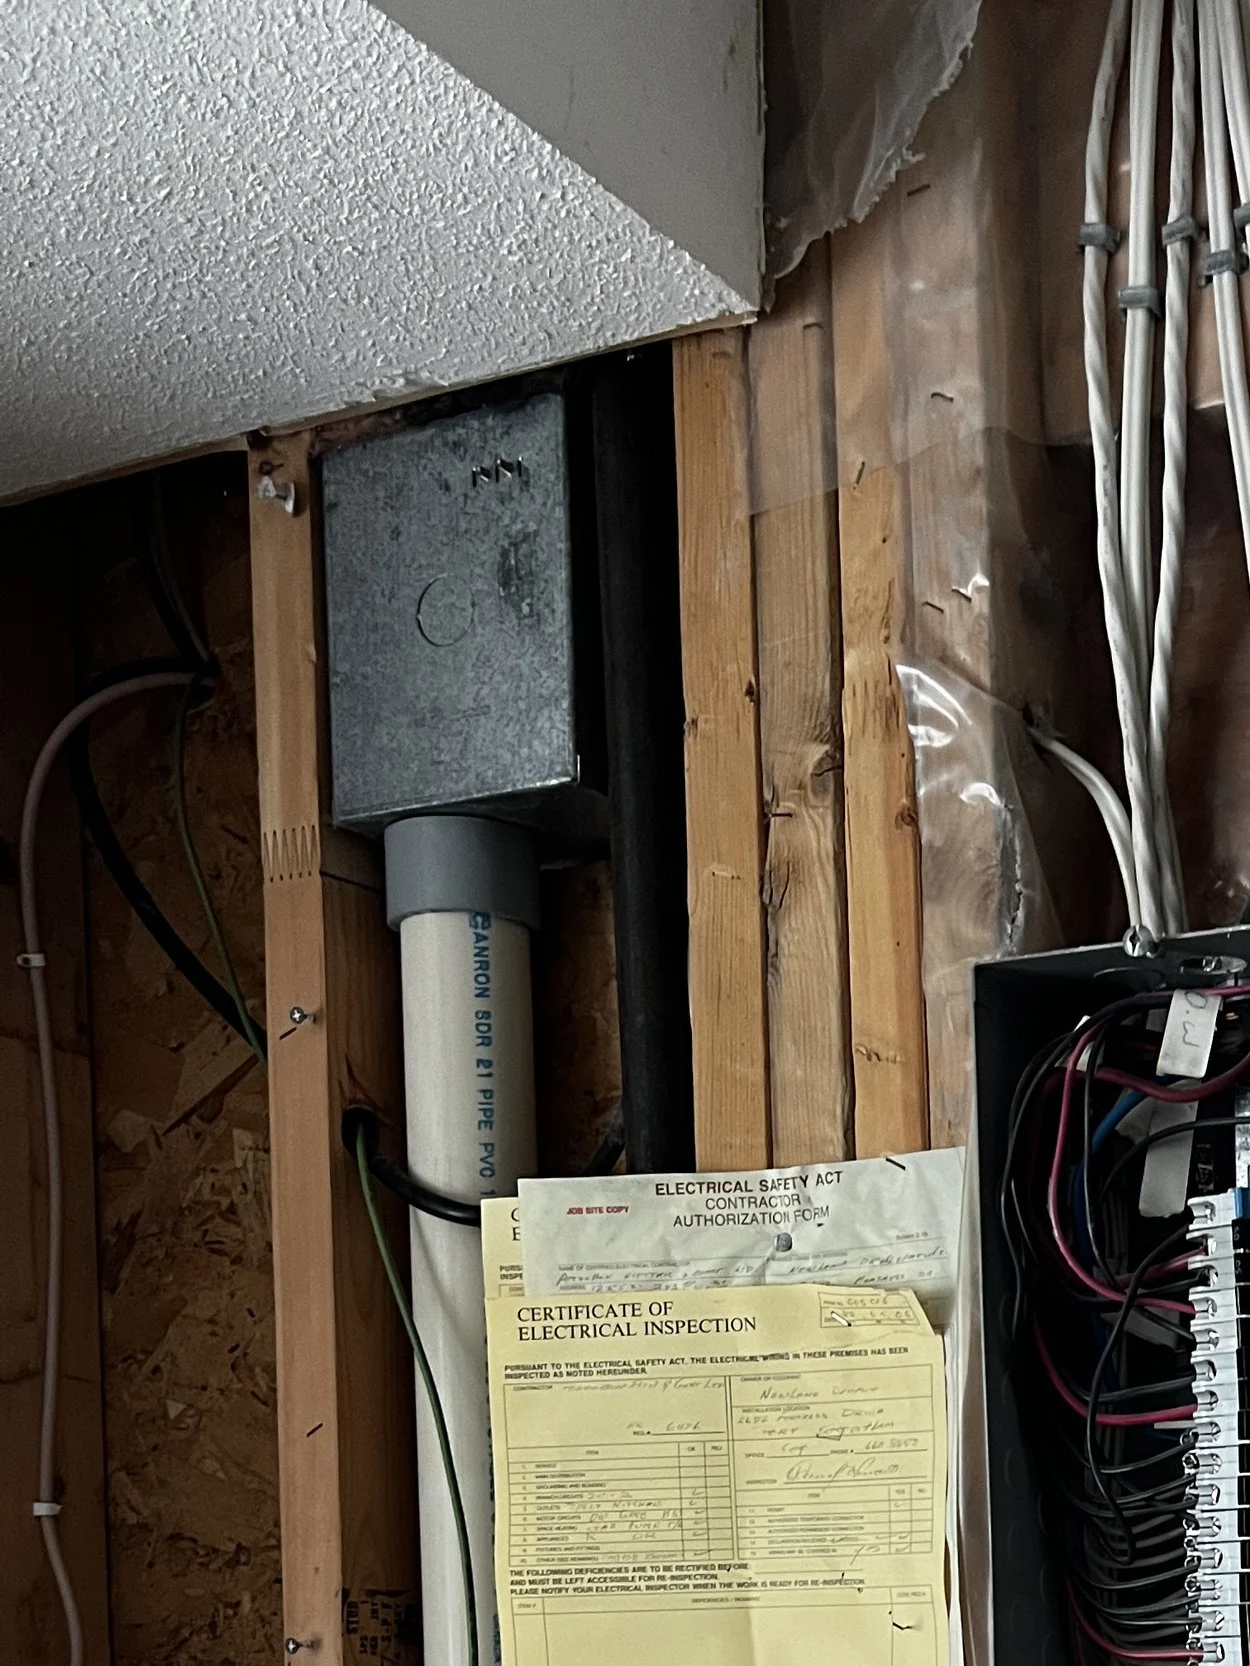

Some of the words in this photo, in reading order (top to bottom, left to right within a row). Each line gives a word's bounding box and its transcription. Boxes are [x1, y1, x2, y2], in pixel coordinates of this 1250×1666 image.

[477, 1089, 495, 1131] PIPE
[479, 1142, 496, 1179] PVC
[655, 1180, 753, 1196] ELECTRICAL
[759, 1175, 809, 1192] SAFETY
[815, 1170, 844, 1185] ACT
[585, 1206, 604, 1214] SITE
[605, 1205, 630, 1214] COPY
[705, 1193, 801, 1210] CONTRACTOR
[673, 1211, 790, 1228] AUTHORIZATION
[794, 1206, 830, 1222] FORM
[517, 1302, 643, 1322] CERTIFICATE
[649, 1301, 674, 1316] OF
[518, 1322, 637, 1341] ELECTRICAL
[644, 1316, 757, 1336] INSPECTION
[504, 1363, 548, 1372] PURSUANT
[550, 1362, 562, 1370] TO
[564, 1362, 581, 1370] THE
[583, 1360, 632, 1369] ELECTRICAL
[635, 1358, 666, 1367] SAFETY
[690, 1356, 707, 1364] THE
[792, 1352, 801, 1360] IN
[803, 1350, 827, 1359] THESE
[829, 1349, 869, 1358] PREMISES
[870, 1348, 886, 1356] HAS
[888, 1346, 909, 1355] BEEN
[504, 1371, 550, 1380] INSPECTED
[553, 1370, 564, 1378] AS
[566, 1369, 594, 1378] NOTED
[509, 1569, 525, 1578] THE
[526, 1568, 572, 1577] FOLLOWING
[573, 1566, 630, 1575] DEFICIENCIES
[631, 1565, 648, 1573] ARE
[650, 1565, 661, 1573] TO
[662, 1564, 674, 1572] BE
[675, 1563, 717, 1572] RECTIFIED
[717, 1563, 749, 1572] BEFORE
[509, 1578, 527, 1587] AND
[528, 1578, 550, 1586] MUST
[551, 1577, 563, 1585] BE
[564, 1576, 585, 1585] LEFT
[586, 1575, 637, 1584] ACCESSIBLE
[638, 1574, 655, 1582] FOR
[510, 1587, 540, 1596] PLEASE
[541, 1586, 570, 1595] NOTIFY
[572, 1585, 594, 1594] YOUR
[595, 1584, 644, 1593] ELECTRICAL
[644, 1583, 690, 1592] INSPECTOR
[692, 1582, 717, 1590] WHEN
[718, 1581, 734, 1590] THE
[735, 1580, 758, 1589] WORK
[760, 1580, 768, 1588] IS
[769, 1579, 793, 1588] READY
[794, 1578, 809, 1587] FOR
